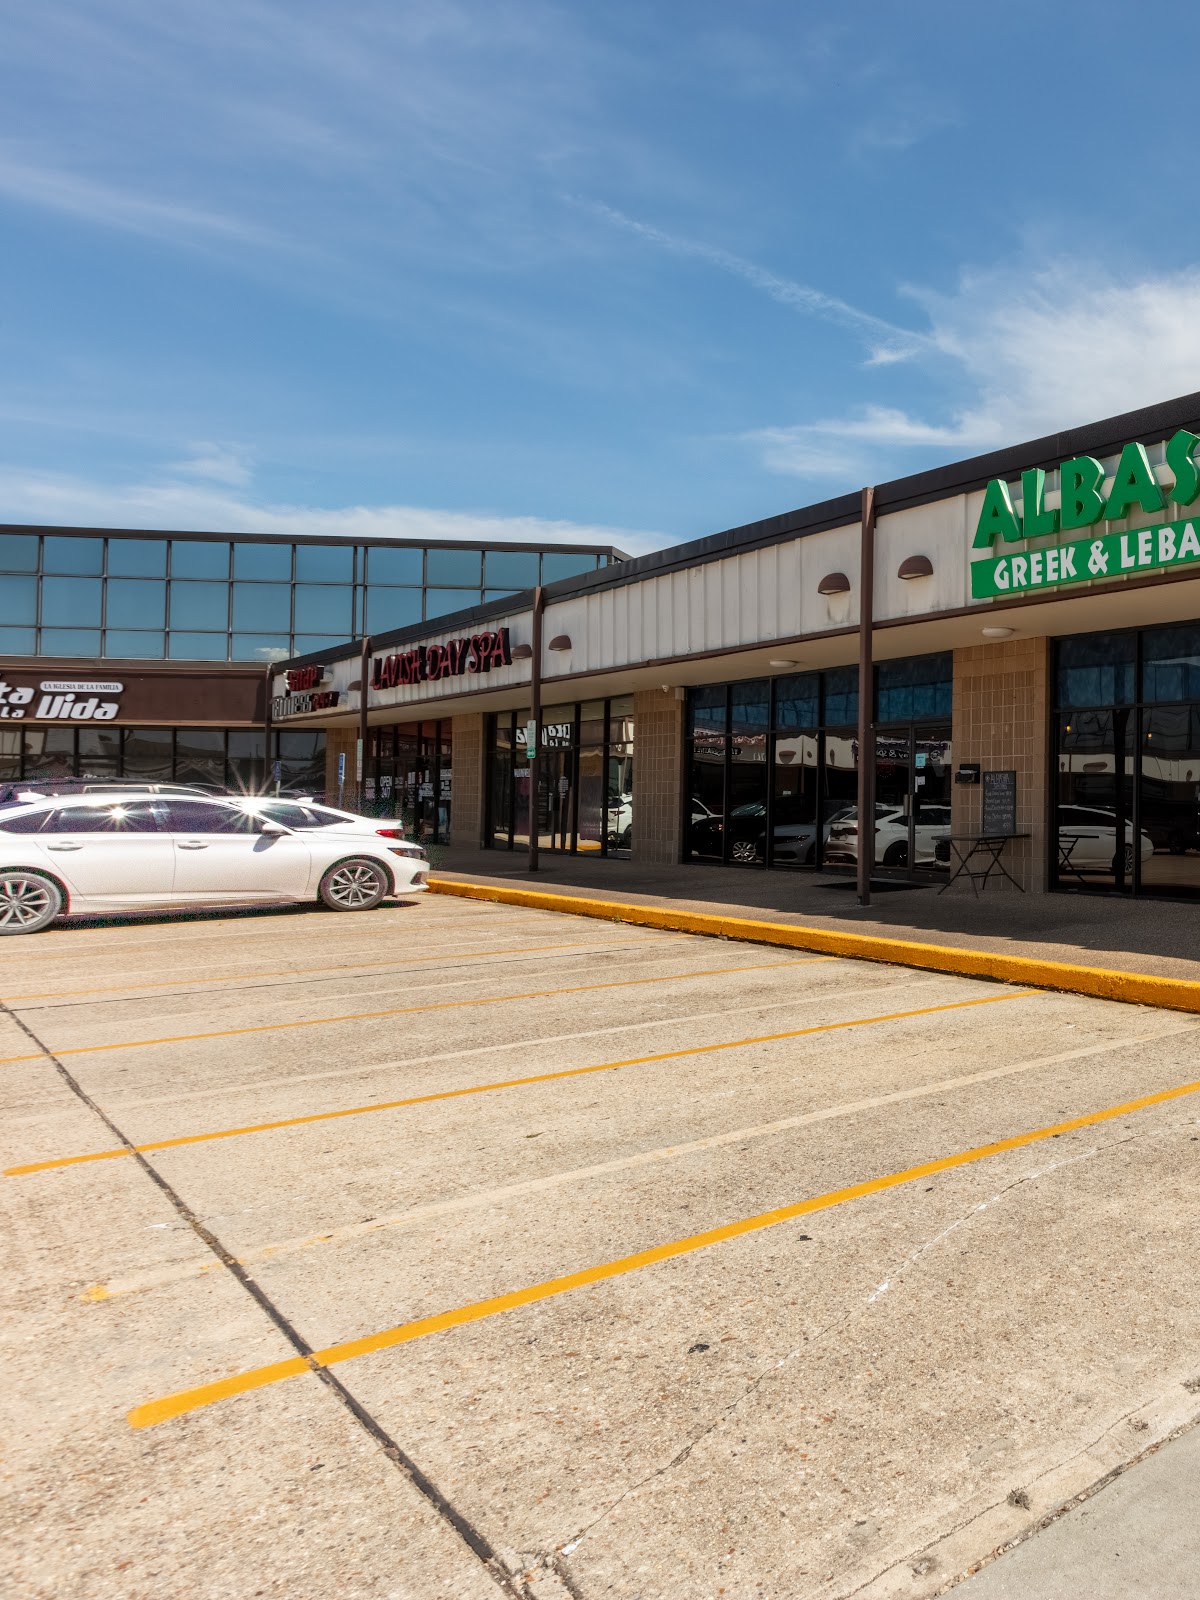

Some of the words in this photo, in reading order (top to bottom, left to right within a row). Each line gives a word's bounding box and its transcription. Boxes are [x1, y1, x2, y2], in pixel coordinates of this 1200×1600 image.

[993, 547, 1077, 590] GREEK
[1088, 540, 1109, 574] &
[373, 647, 424, 690] LAVISH
[427, 638, 466, 681] DAY
[468, 627, 512, 674] SPA
